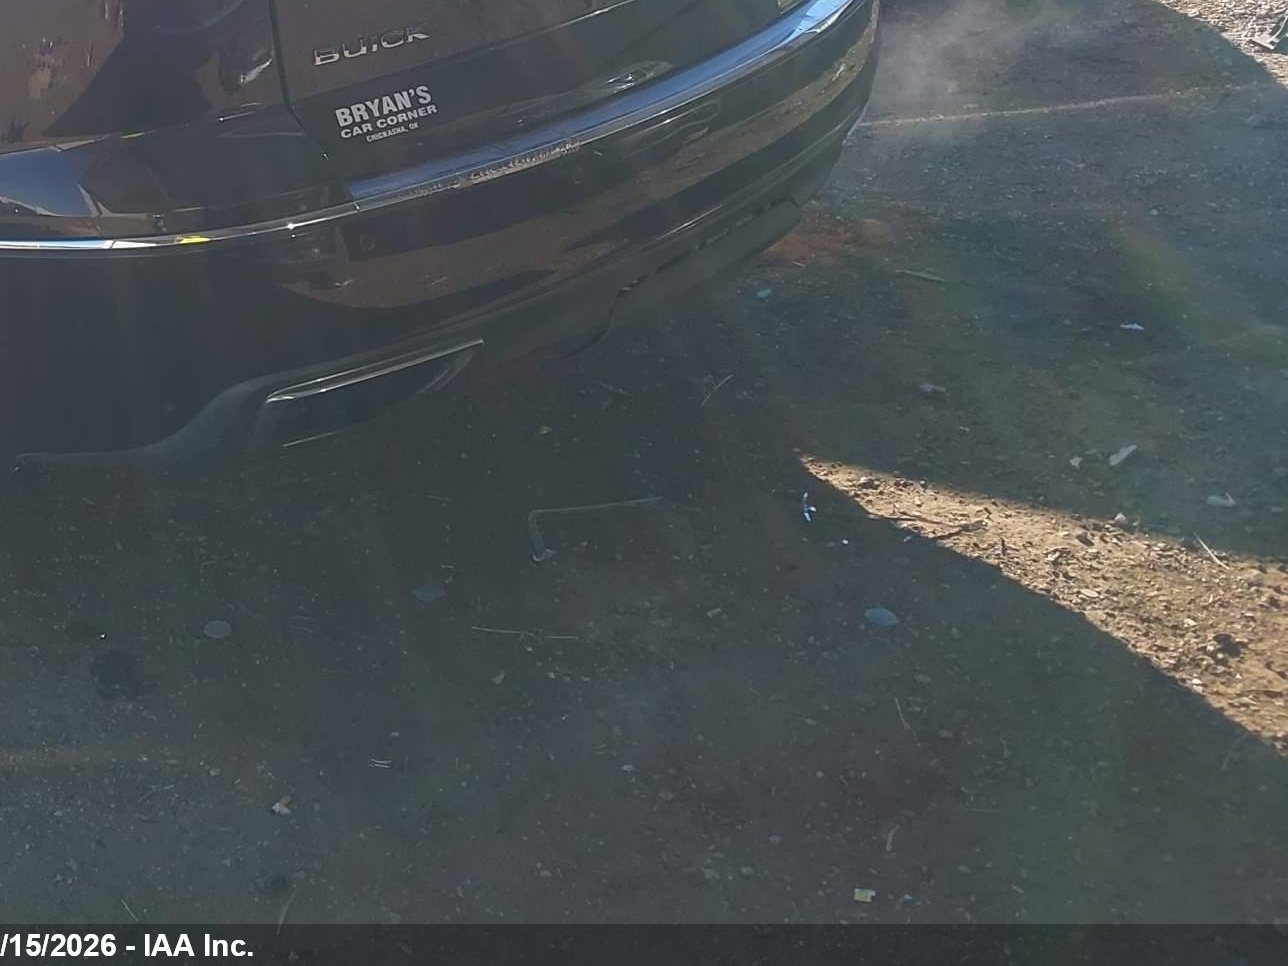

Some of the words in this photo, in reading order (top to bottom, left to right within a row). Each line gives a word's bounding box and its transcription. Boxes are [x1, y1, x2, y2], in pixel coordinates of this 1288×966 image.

[314, 22, 430, 66] BUICK
[335, 85, 432, 127] BRYAN'S
[340, 123, 373, 139] CAR
[376, 105, 437, 128] CORNER
